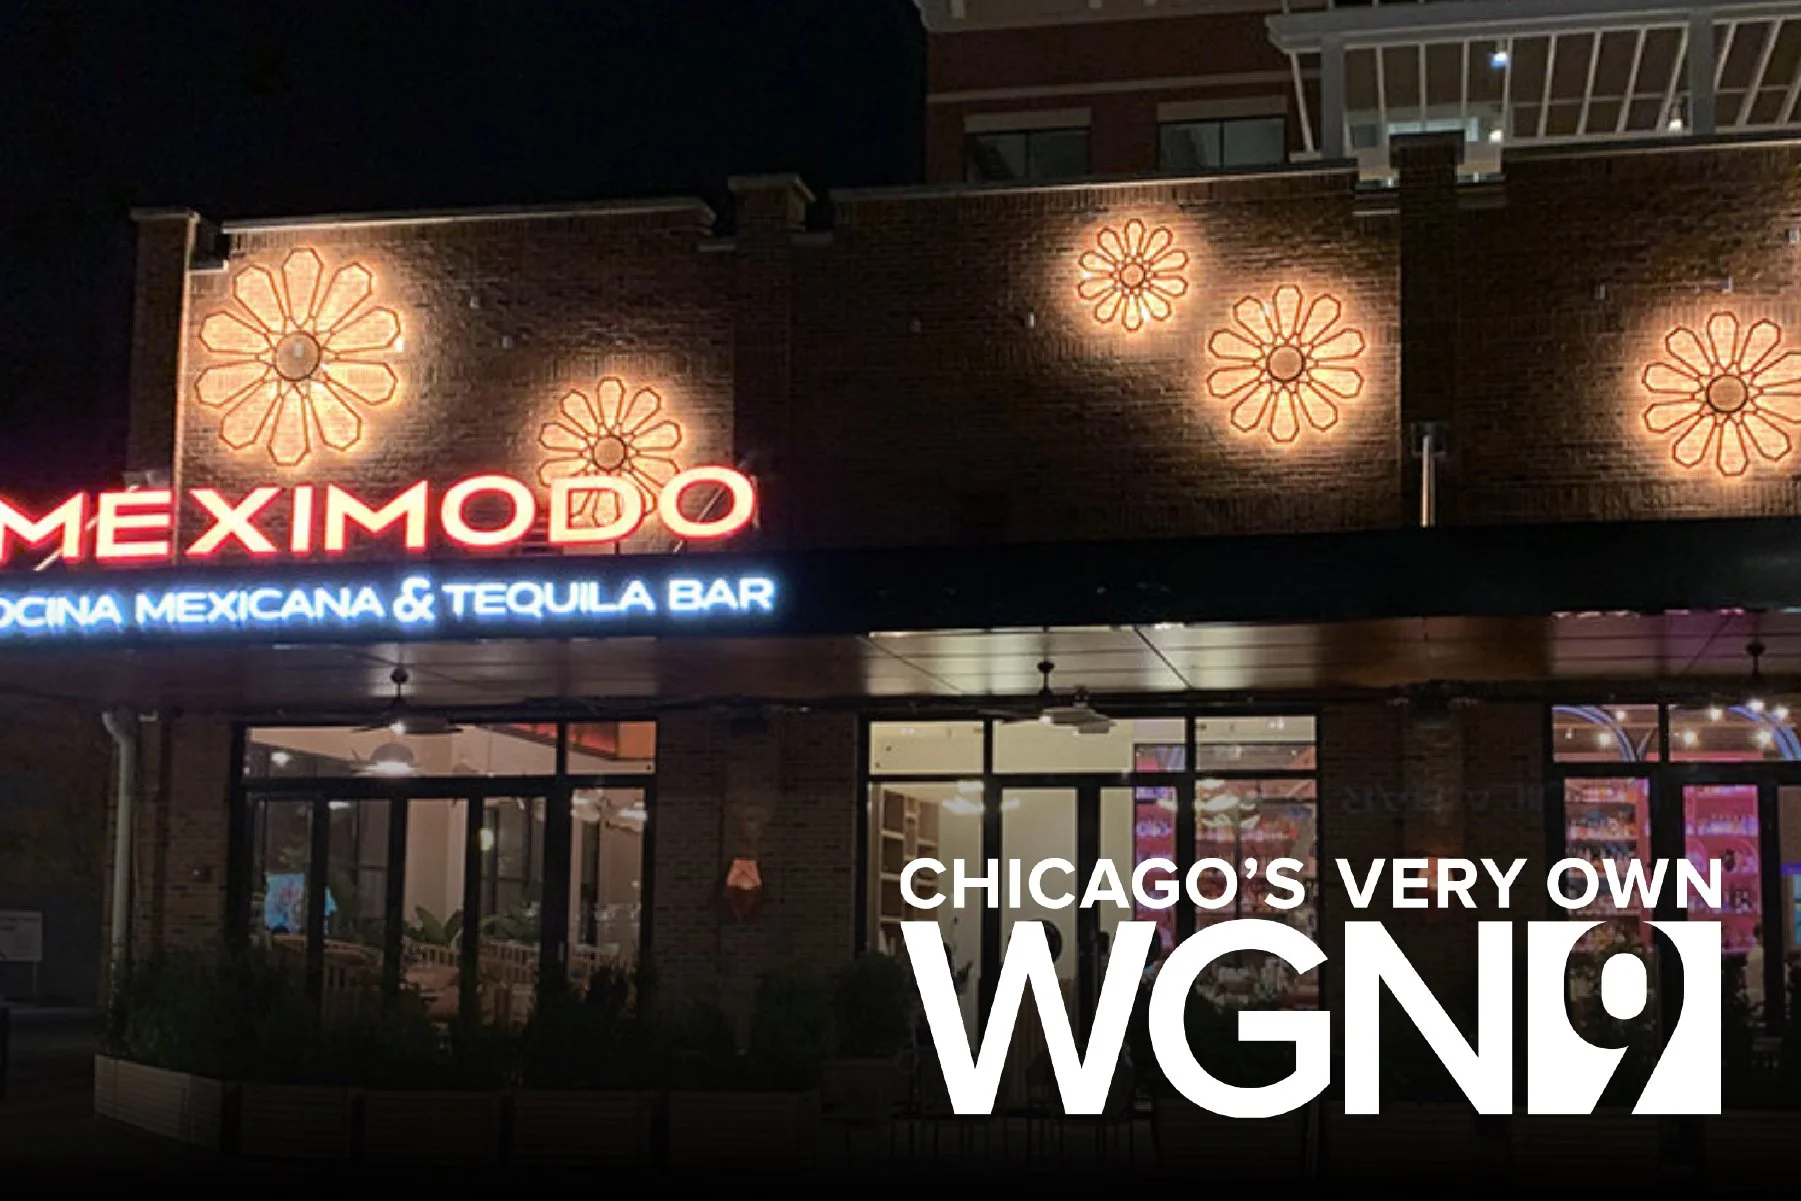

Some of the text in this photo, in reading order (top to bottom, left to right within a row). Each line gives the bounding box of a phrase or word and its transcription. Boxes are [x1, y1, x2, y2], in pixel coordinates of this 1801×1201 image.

[0, 466, 757, 565] MEXIMODO
[136, 585, 384, 624] MEXICANA
[392, 576, 435, 622] &
[442, 579, 655, 617] TEQUILA
[668, 577, 775, 611] BAR
